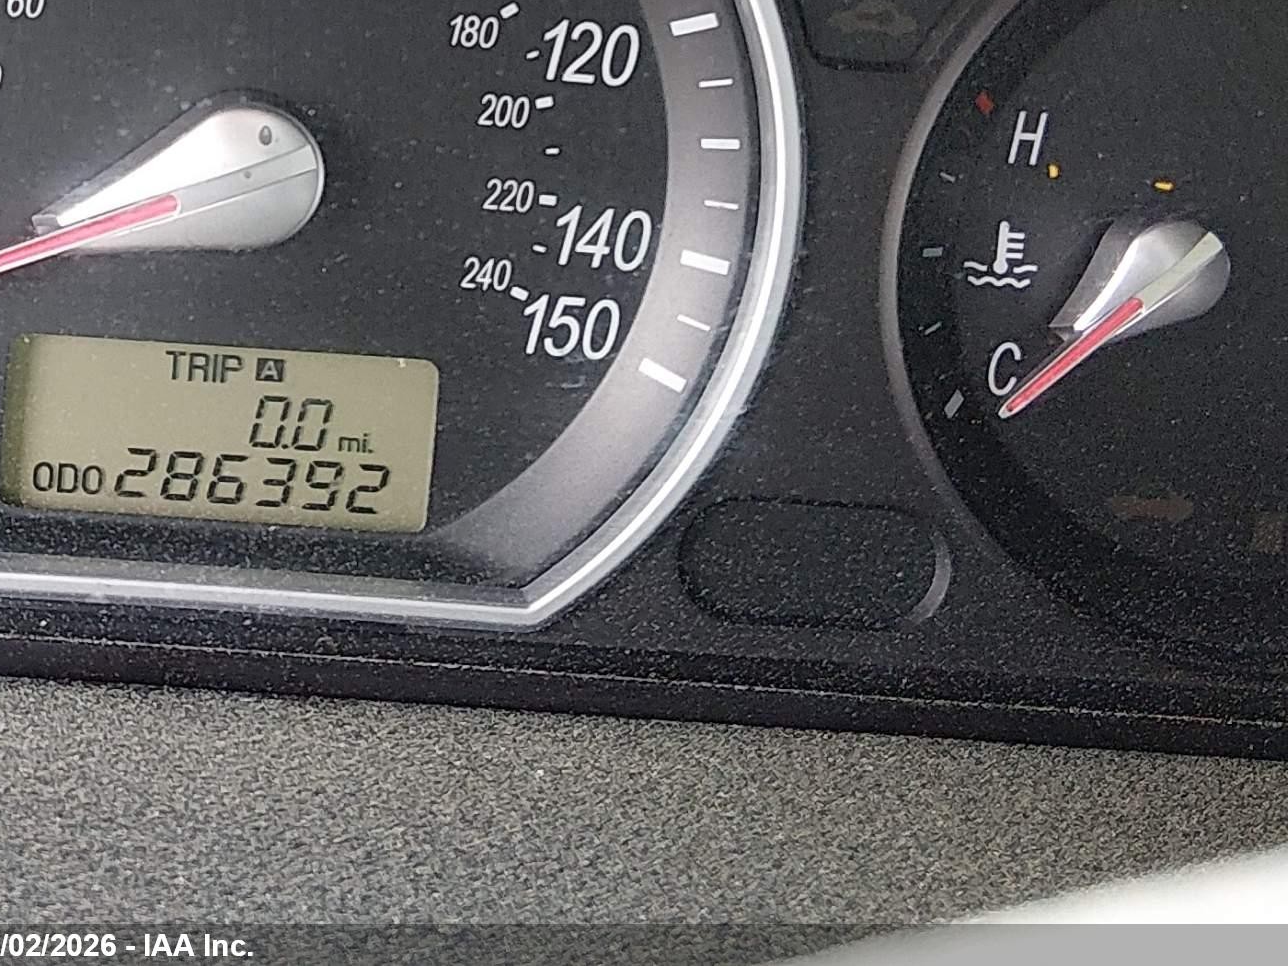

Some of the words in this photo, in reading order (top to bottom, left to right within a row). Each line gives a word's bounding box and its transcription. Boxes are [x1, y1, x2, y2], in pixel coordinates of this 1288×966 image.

[449, 14, 499, 49] 180
[541, 20, 641, 88] 120
[478, 93, 530, 129] 200
[1008, 110, 1049, 166] H
[483, 179, 535, 213] 220
[554, 205, 653, 273] 140
[460, 257, 512, 293] 240
[522, 297, 620, 361] 150
[165, 349, 244, 383] TRIP
[988, 341, 1022, 397] C
[249, 395, 334, 452] 0.0
[32, 461, 104, 495] ODO
[113, 447, 390, 515] 286392
